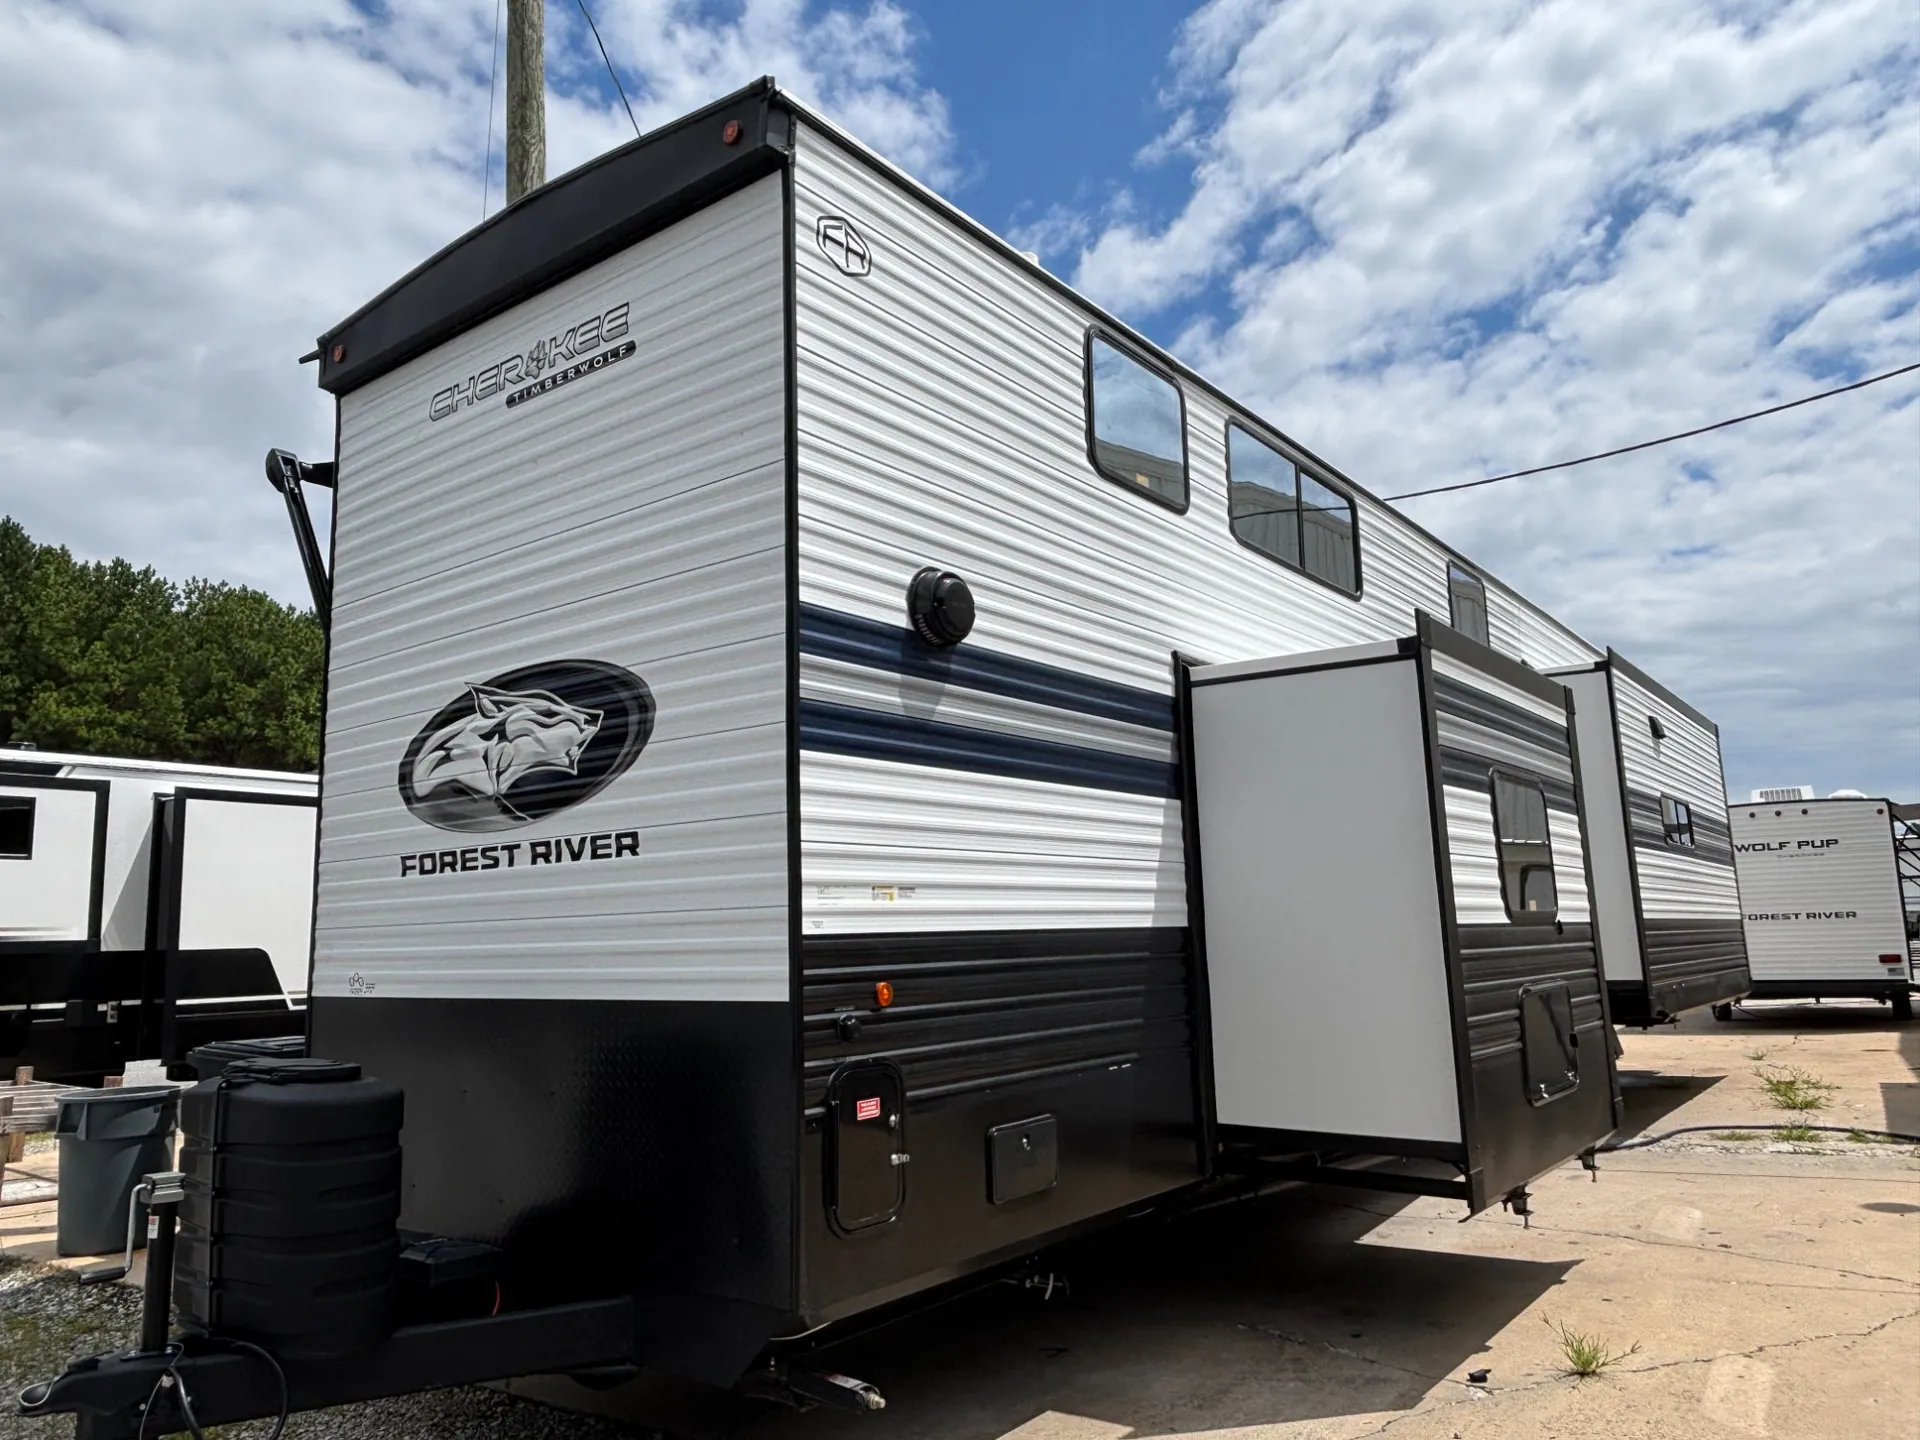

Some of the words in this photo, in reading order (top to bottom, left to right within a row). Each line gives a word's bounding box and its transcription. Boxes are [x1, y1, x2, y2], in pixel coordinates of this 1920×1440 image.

[512, 344, 628, 404] TIMBERWOLF
[400, 843, 521, 877] FOREST
[529, 831, 640, 865] RIVER
[1734, 842, 1791, 853] WOLF
[1797, 839, 1838, 850] PUP
[1805, 911, 1857, 920] RIVER
